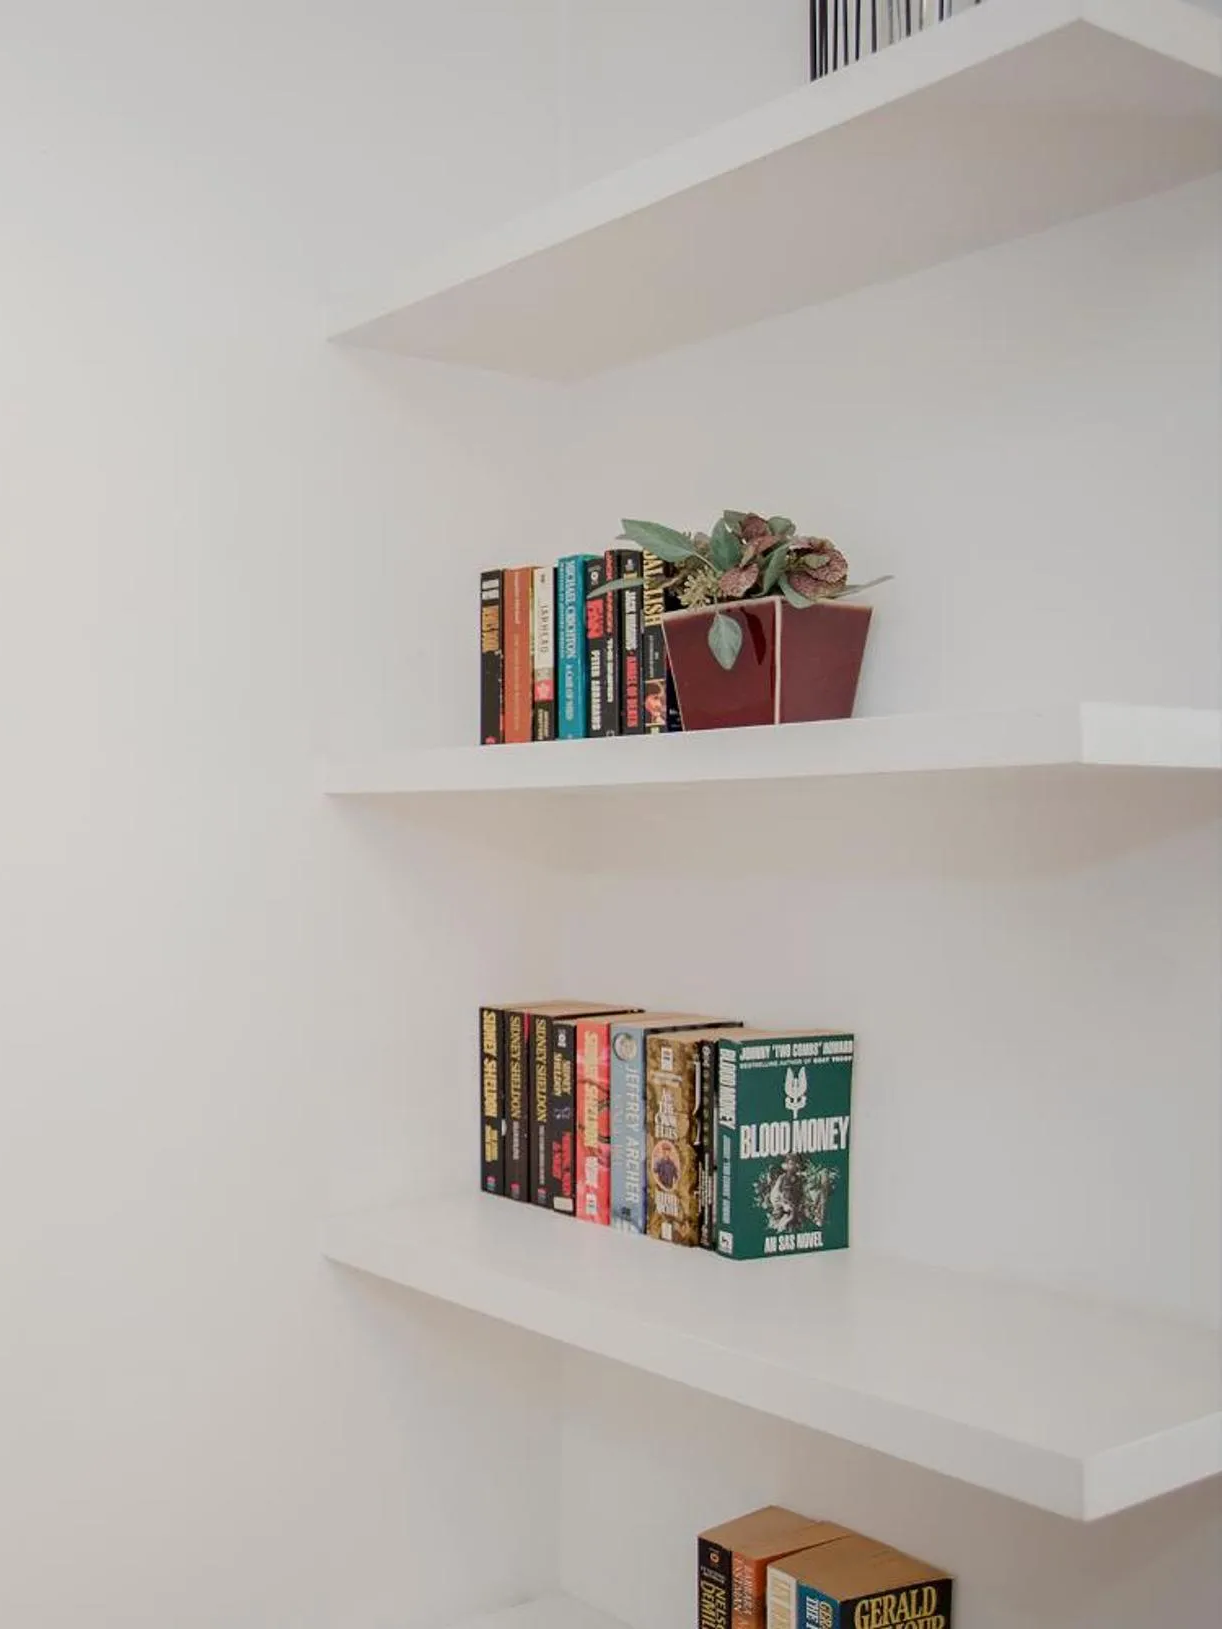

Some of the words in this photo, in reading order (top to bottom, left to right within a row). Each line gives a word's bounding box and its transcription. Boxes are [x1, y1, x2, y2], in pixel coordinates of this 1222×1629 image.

[483, 1010, 496, 1056] SIDNEY
[510, 1015, 522, 1060] SIDNEY
[535, 1018, 547, 1064] SIDNEY
[484, 1057, 498, 1118] SHELDON
[510, 1060, 522, 1120] SHELDON
[719, 1047, 737, 1087] BLOOD
[535, 1063, 547, 1123] SHELDON
[625, 1065, 640, 1133] JEFFREY
[719, 1085, 737, 1131] MONEY
[739, 1120, 791, 1160] BLOOD
[792, 1115, 850, 1155] MONEY
[625, 1135, 641, 1205] ARCHER
[764, 1235, 777, 1254] AN
[778, 1233, 796, 1252] SAS
[796, 1230, 824, 1250] NOVEL
[806, 1596, 819, 1623] THE
[854, 1586, 938, 1629] GERALD
